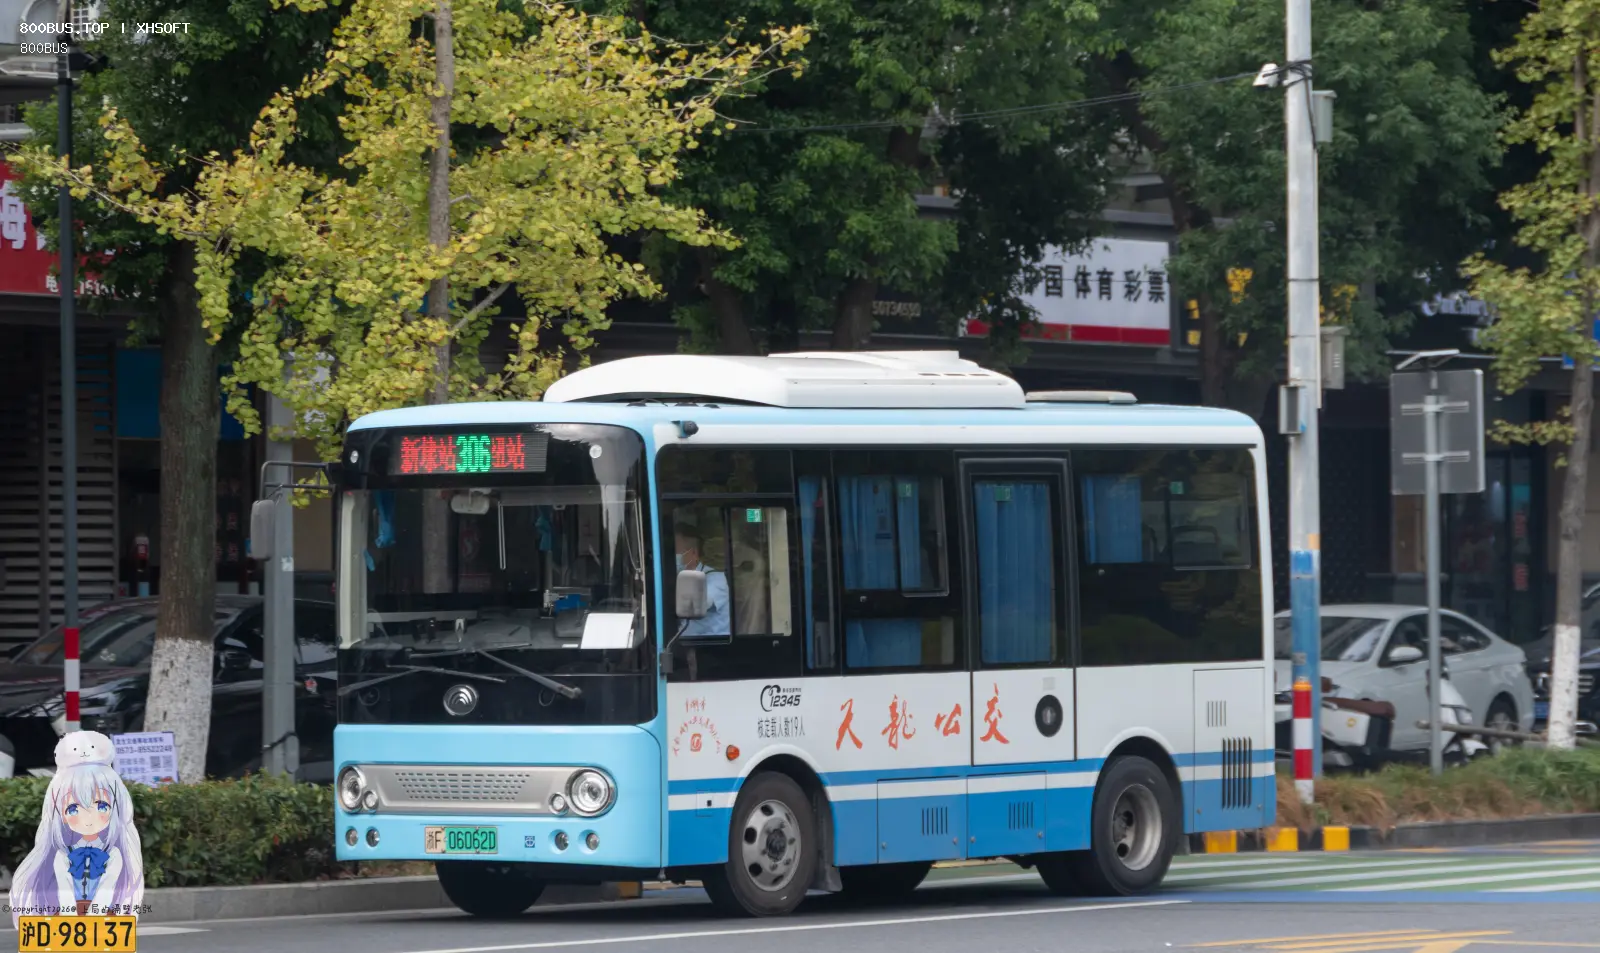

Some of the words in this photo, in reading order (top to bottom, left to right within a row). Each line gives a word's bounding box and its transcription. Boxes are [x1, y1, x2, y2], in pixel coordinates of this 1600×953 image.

[456, 434, 491, 473] 306
[770, 694, 801, 707] 12345
[449, 830, 496, 850] 06062D
